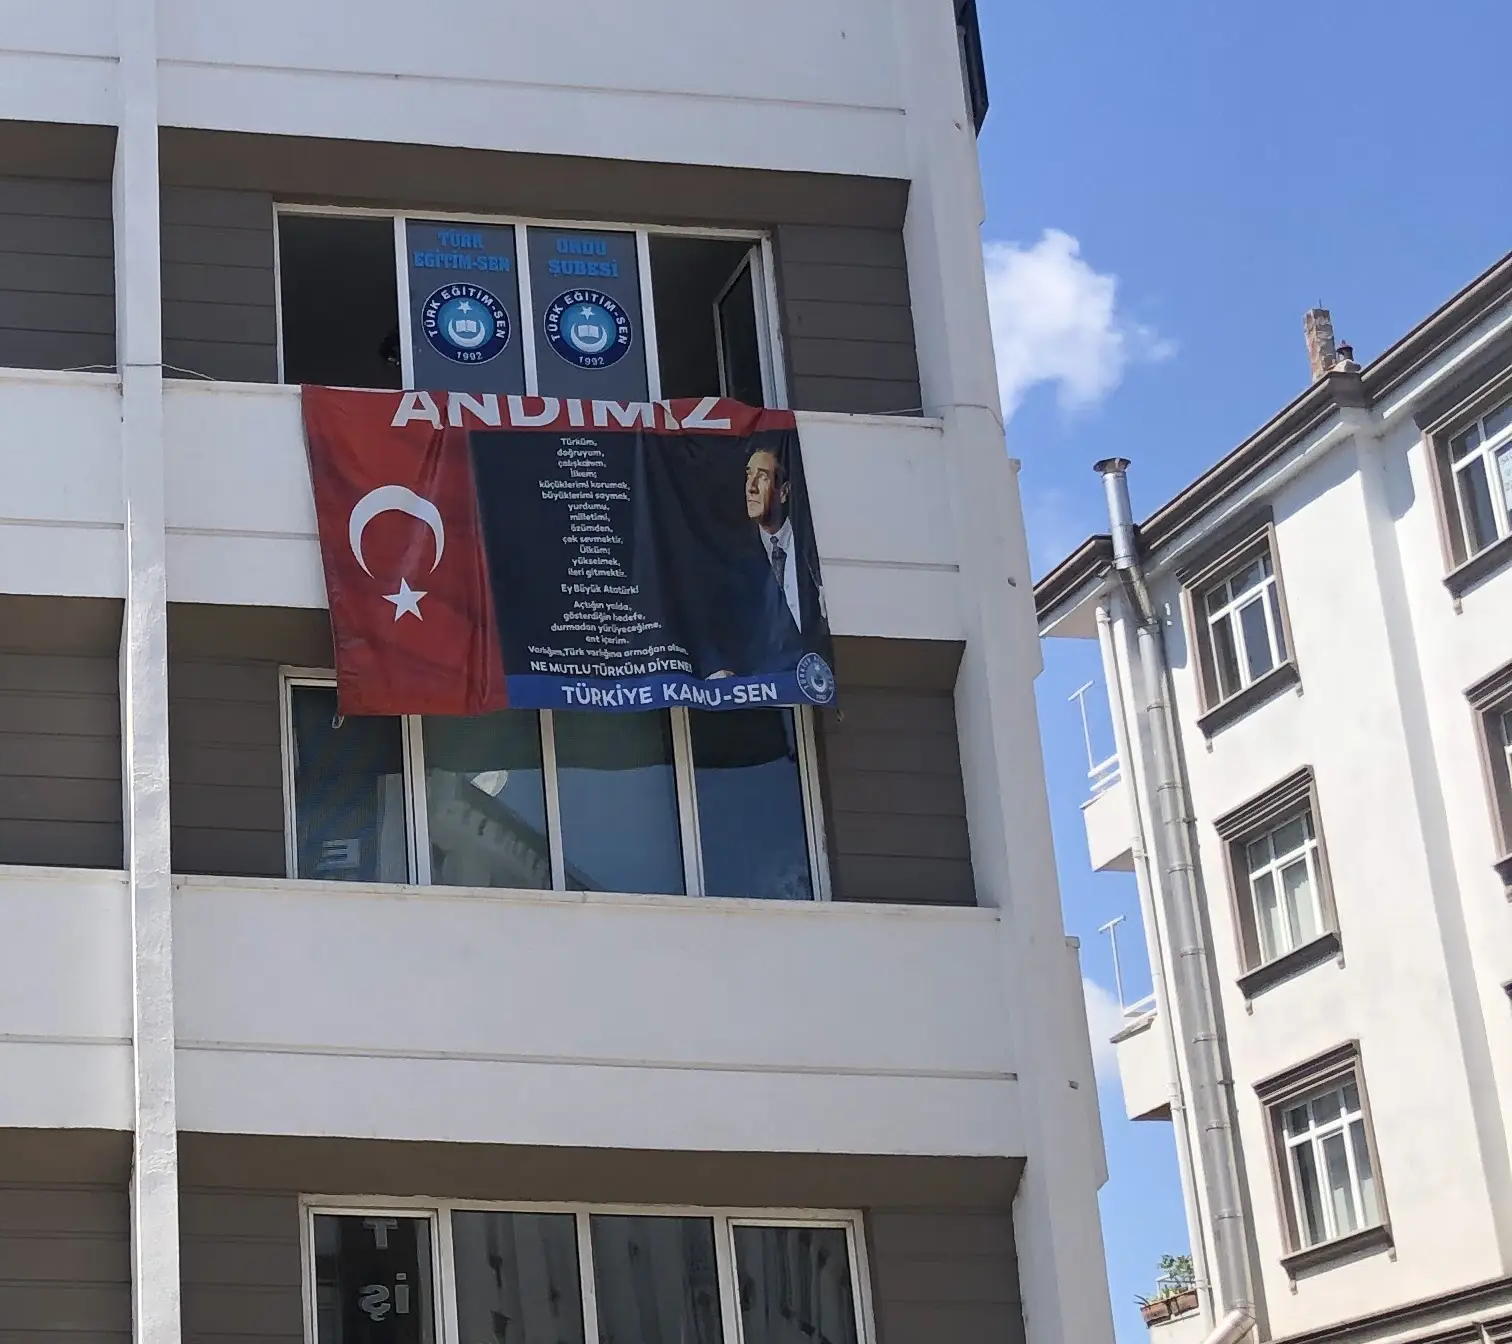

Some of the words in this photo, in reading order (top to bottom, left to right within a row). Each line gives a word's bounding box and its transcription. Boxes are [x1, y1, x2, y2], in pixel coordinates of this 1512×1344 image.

[548, 258, 619, 278] ŞUBESİ
[424, 299, 441, 338] TÜRK
[548, 304, 564, 342] TÜRK
[457, 351, 482, 361] 1992
[579, 356, 605, 366] 1992
[574, 584, 601, 594] Büyük
[530, 660, 546, 671] NE
[549, 662, 591, 675] MUTLU
[592, 662, 645, 676] TÜRKÜM
[561, 682, 653, 706] TÜRKİYE
[662, 682, 778, 707] KAMU-SEN
